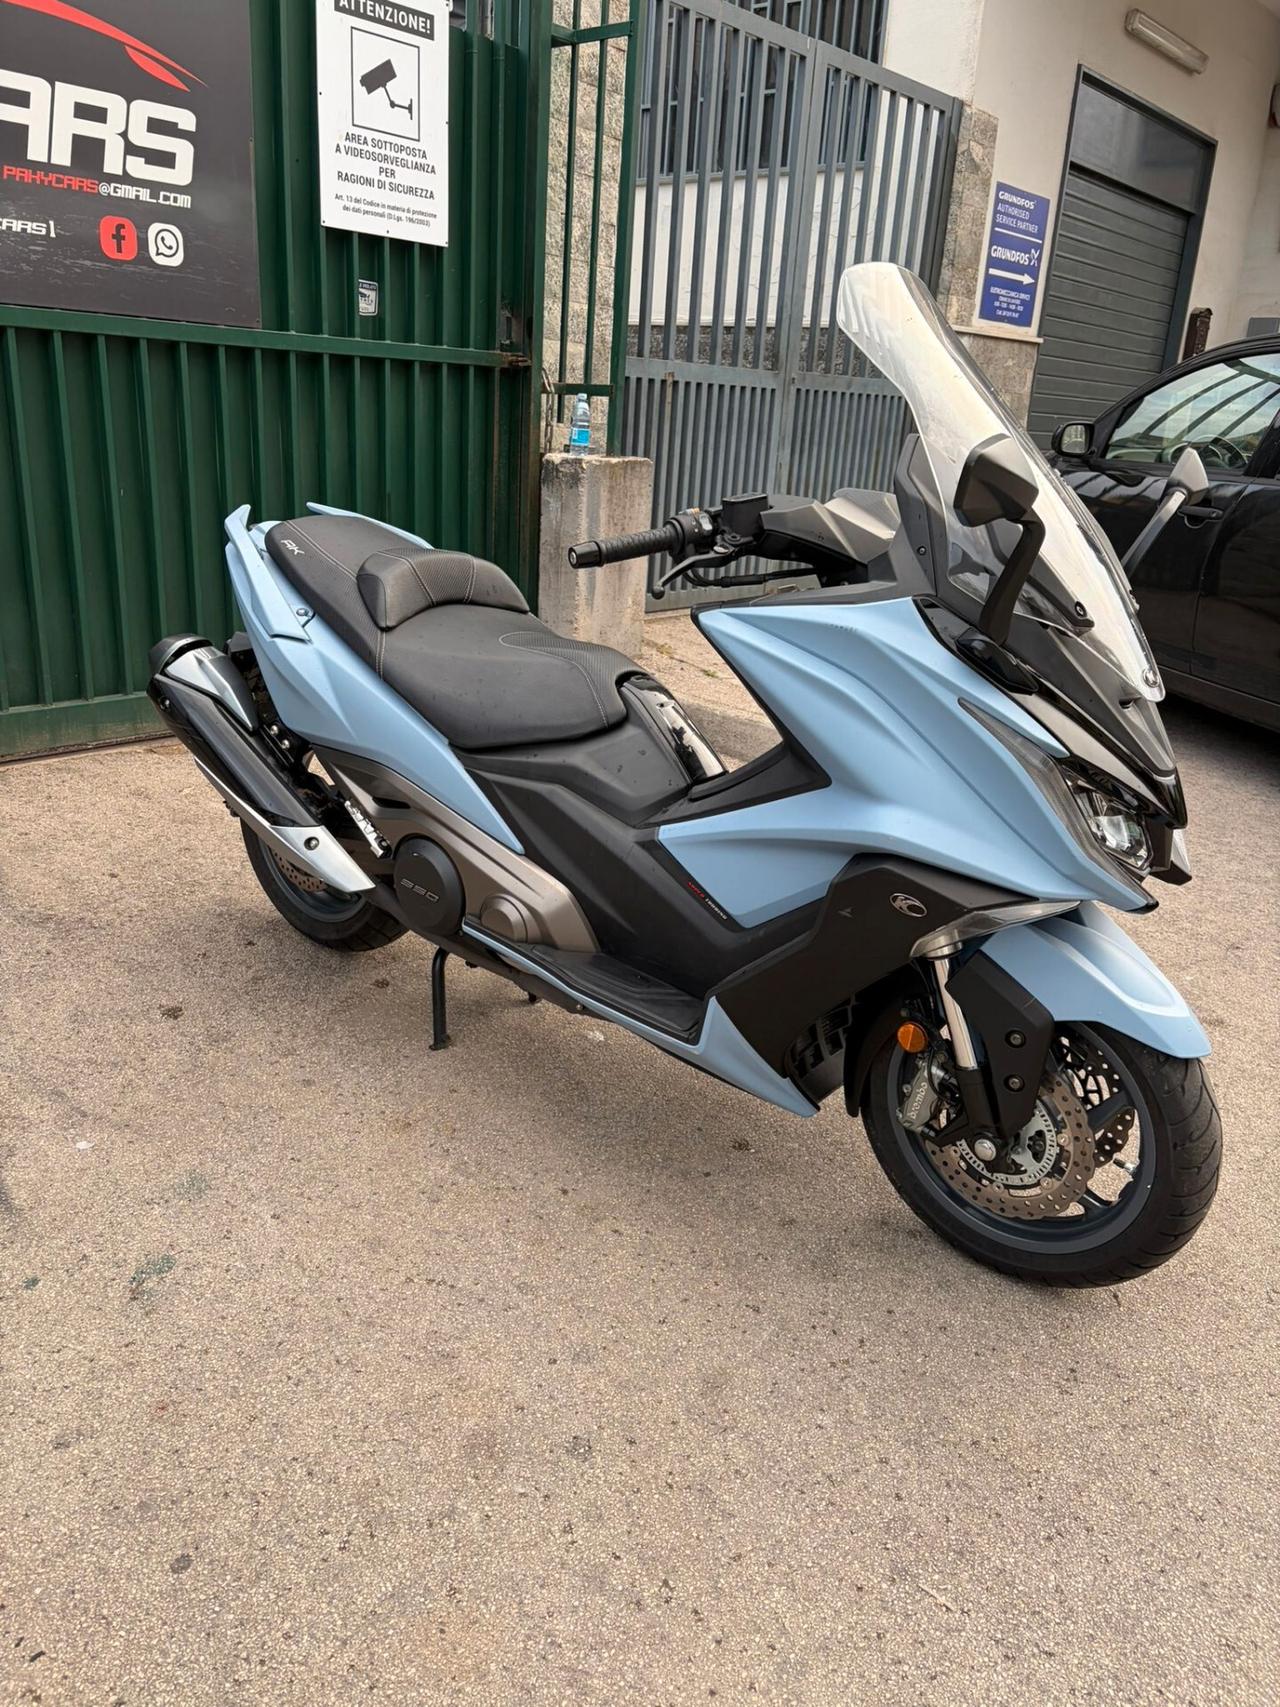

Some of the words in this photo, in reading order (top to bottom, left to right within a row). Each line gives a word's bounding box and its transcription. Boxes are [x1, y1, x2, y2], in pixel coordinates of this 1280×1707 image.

[339, 0, 431, 34] ATTENZIONE!
[345, 132, 369, 147] AREA
[371, 138, 427, 160] SOTTOPOSTA
[335, 143, 342, 154] A
[344, 145, 436, 175] VIDEOSORVEGLIANZA
[379, 166, 396, 179] PER
[337, 170, 375, 188] RAGIONI
[377, 179, 386, 190] DI
[388, 181, 435, 200] SICUREZZA
[335, 193, 345, 201] Art.
[363, 198, 380, 208] Codice
[387, 204, 406, 213] materia
[412, 209, 437, 219] protezione
[997, 202, 1030, 220] AUTHORISED
[998, 191, 1035, 209] GRUNDFOS
[363, 209, 386, 219] personali
[995, 213, 1017, 228] SERVICE
[1017, 220, 1038, 234] PARTNER
[990, 245, 1030, 266] GRUNDFOS
[907, 1082, 928, 1120] brembo
